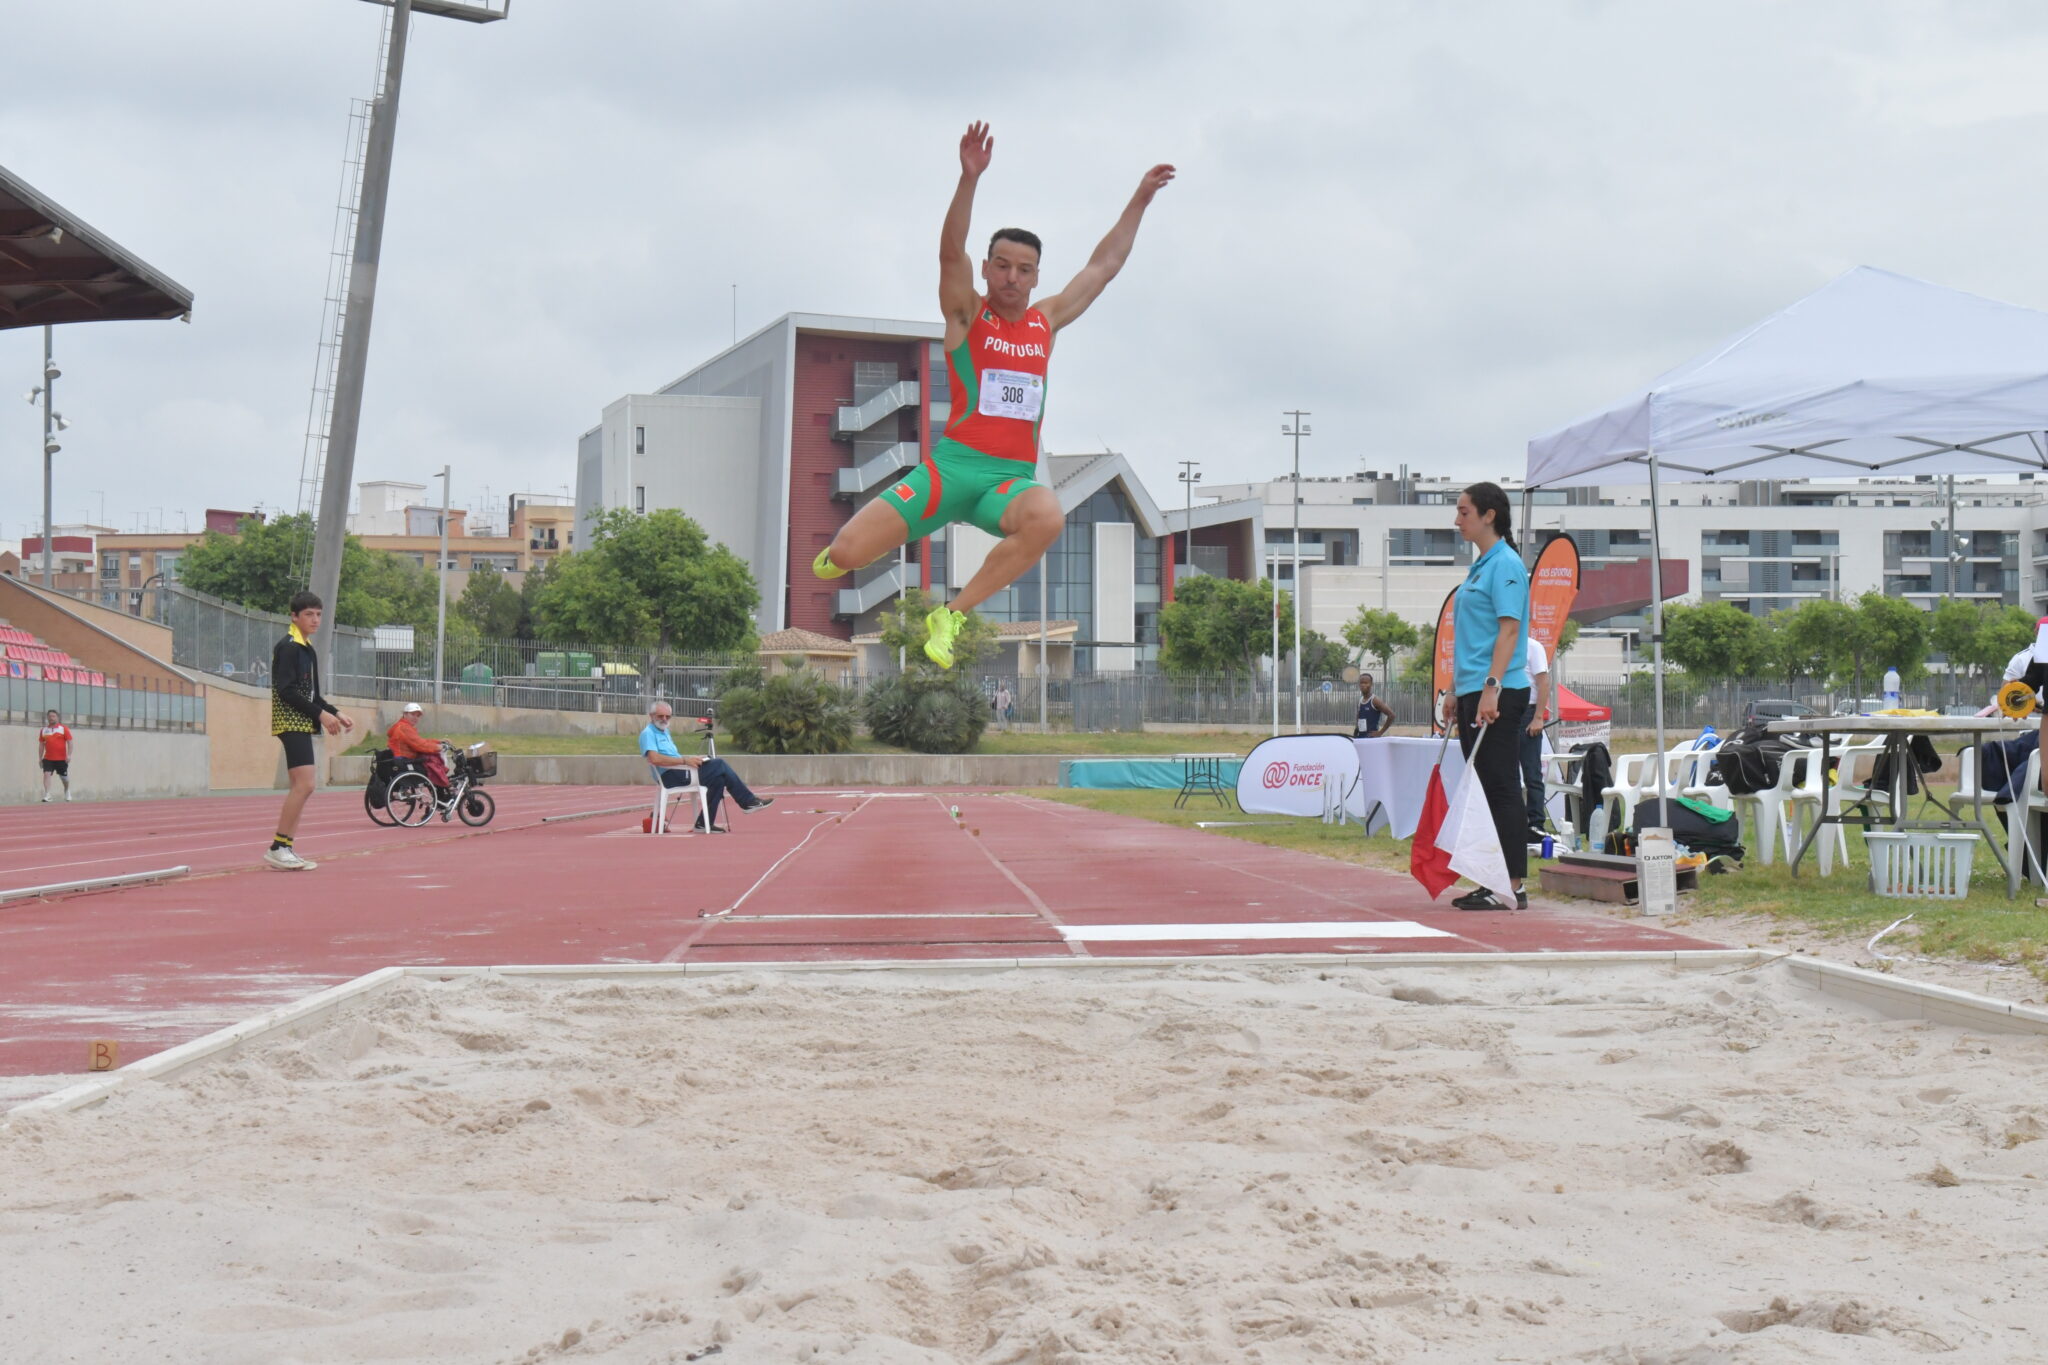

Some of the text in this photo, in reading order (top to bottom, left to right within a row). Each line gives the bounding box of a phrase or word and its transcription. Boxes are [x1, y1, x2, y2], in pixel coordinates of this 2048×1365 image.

[984, 336, 1046, 358] PORTUGAL
[1001, 385, 1024, 404] 308
[1293, 763, 1325, 771] Fundación
[1289, 773, 1322, 786] ONCE
[96, 1043, 113, 1069] B
